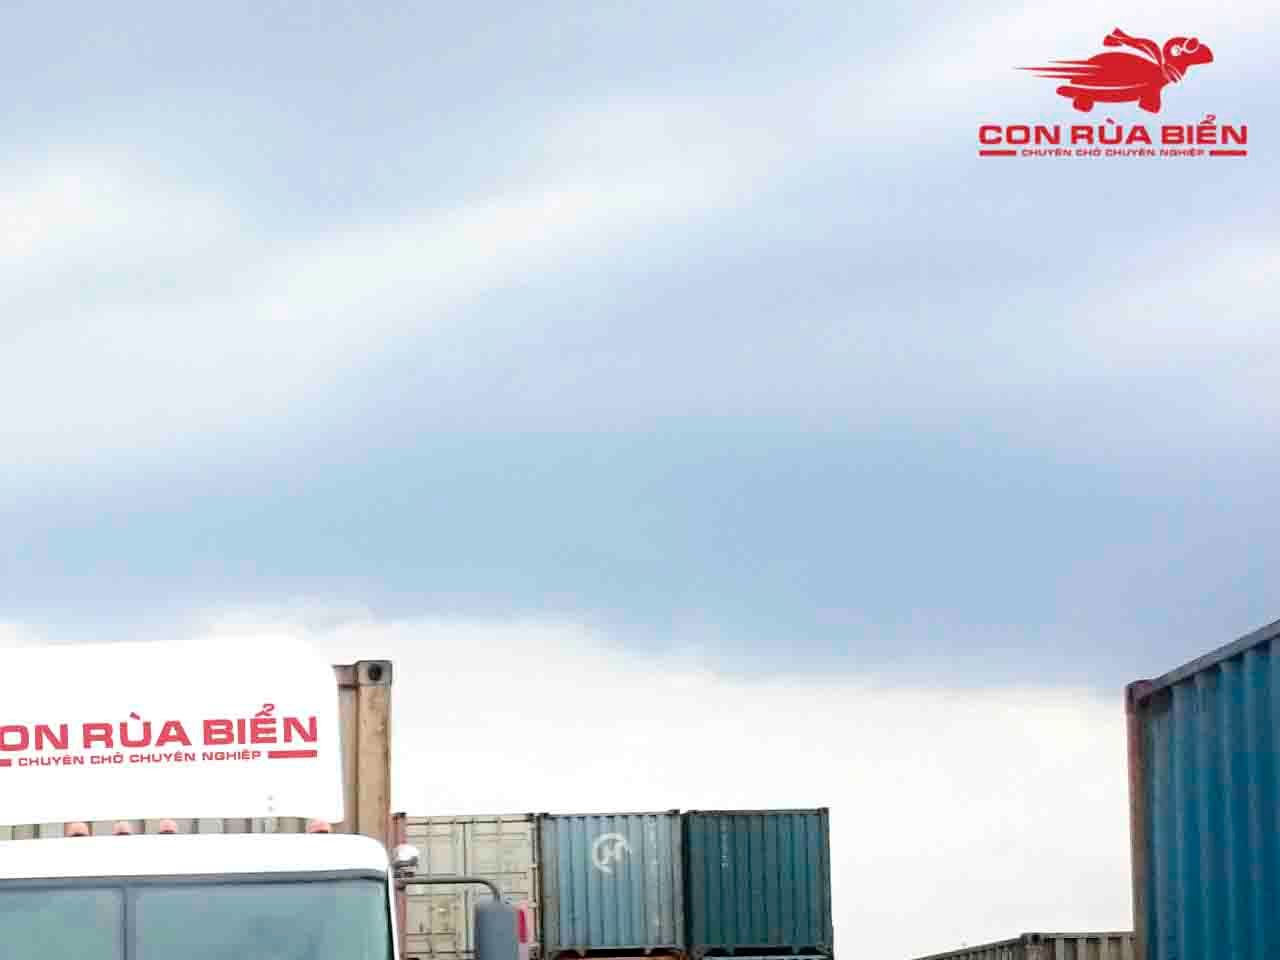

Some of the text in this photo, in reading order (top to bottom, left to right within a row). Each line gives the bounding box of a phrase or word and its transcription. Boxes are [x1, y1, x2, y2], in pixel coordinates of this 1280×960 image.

[82, 711, 192, 750] RÙA
[203, 703, 318, 746] BIỂN
[18, 754, 85, 767] CHUYÊN
[129, 750, 197, 764] CHUYÊN
